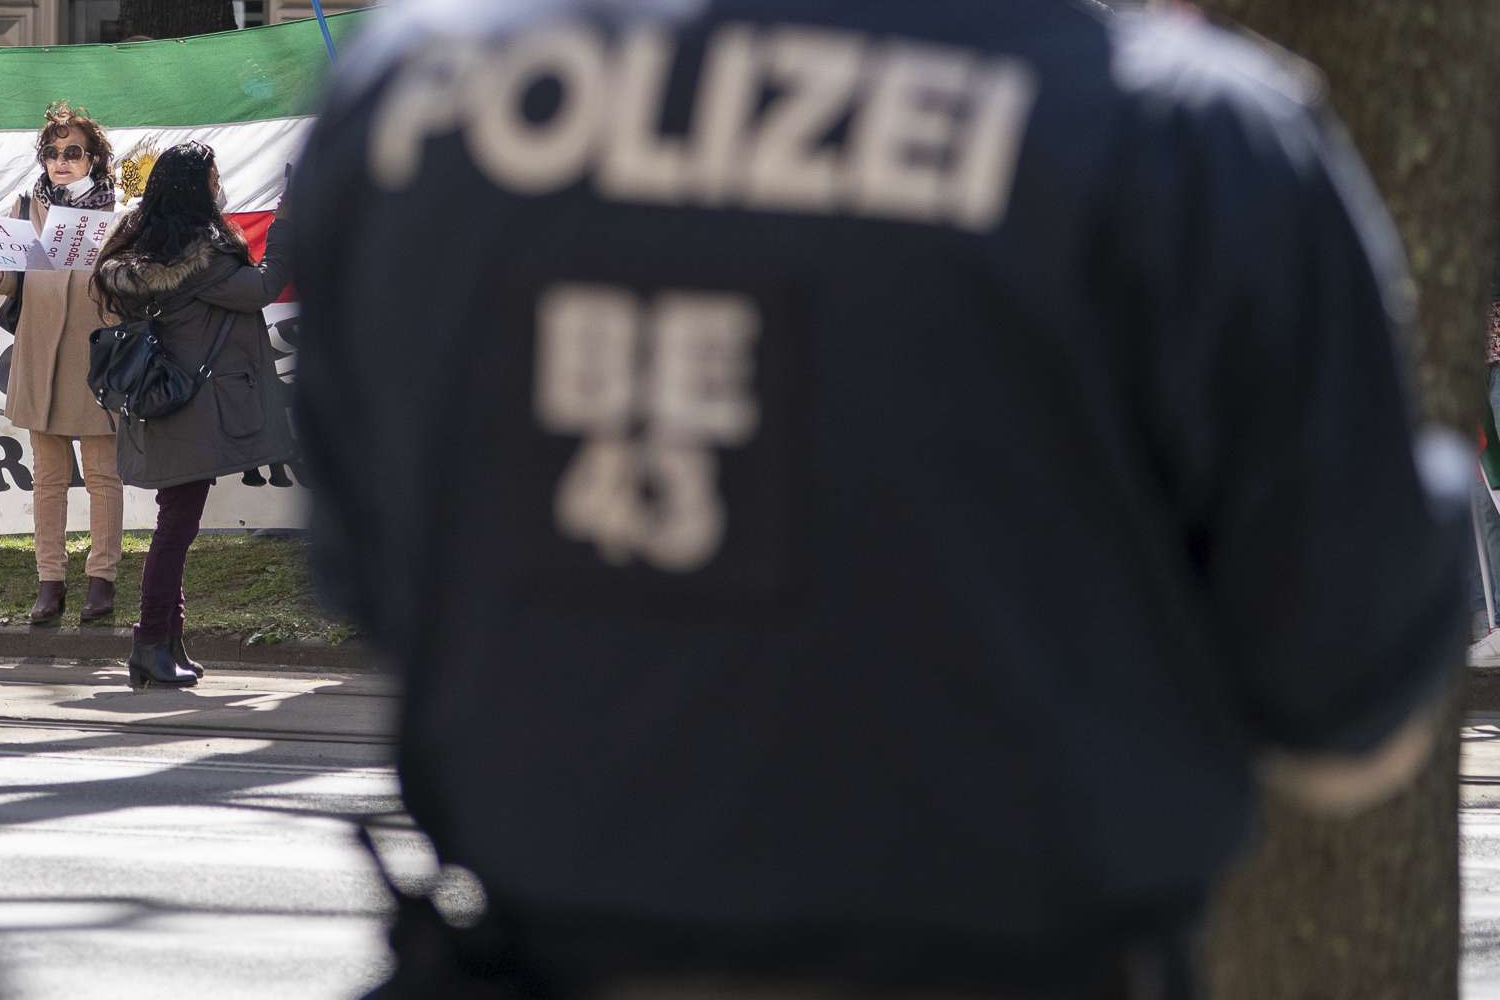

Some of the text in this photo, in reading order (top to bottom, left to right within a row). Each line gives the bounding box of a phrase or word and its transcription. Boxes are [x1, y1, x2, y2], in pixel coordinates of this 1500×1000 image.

[368, 22, 1037, 232] POLIZEI
[53, 223, 66, 243] not
[64, 215, 89, 267] negotiate
[93, 221, 108, 241] the
